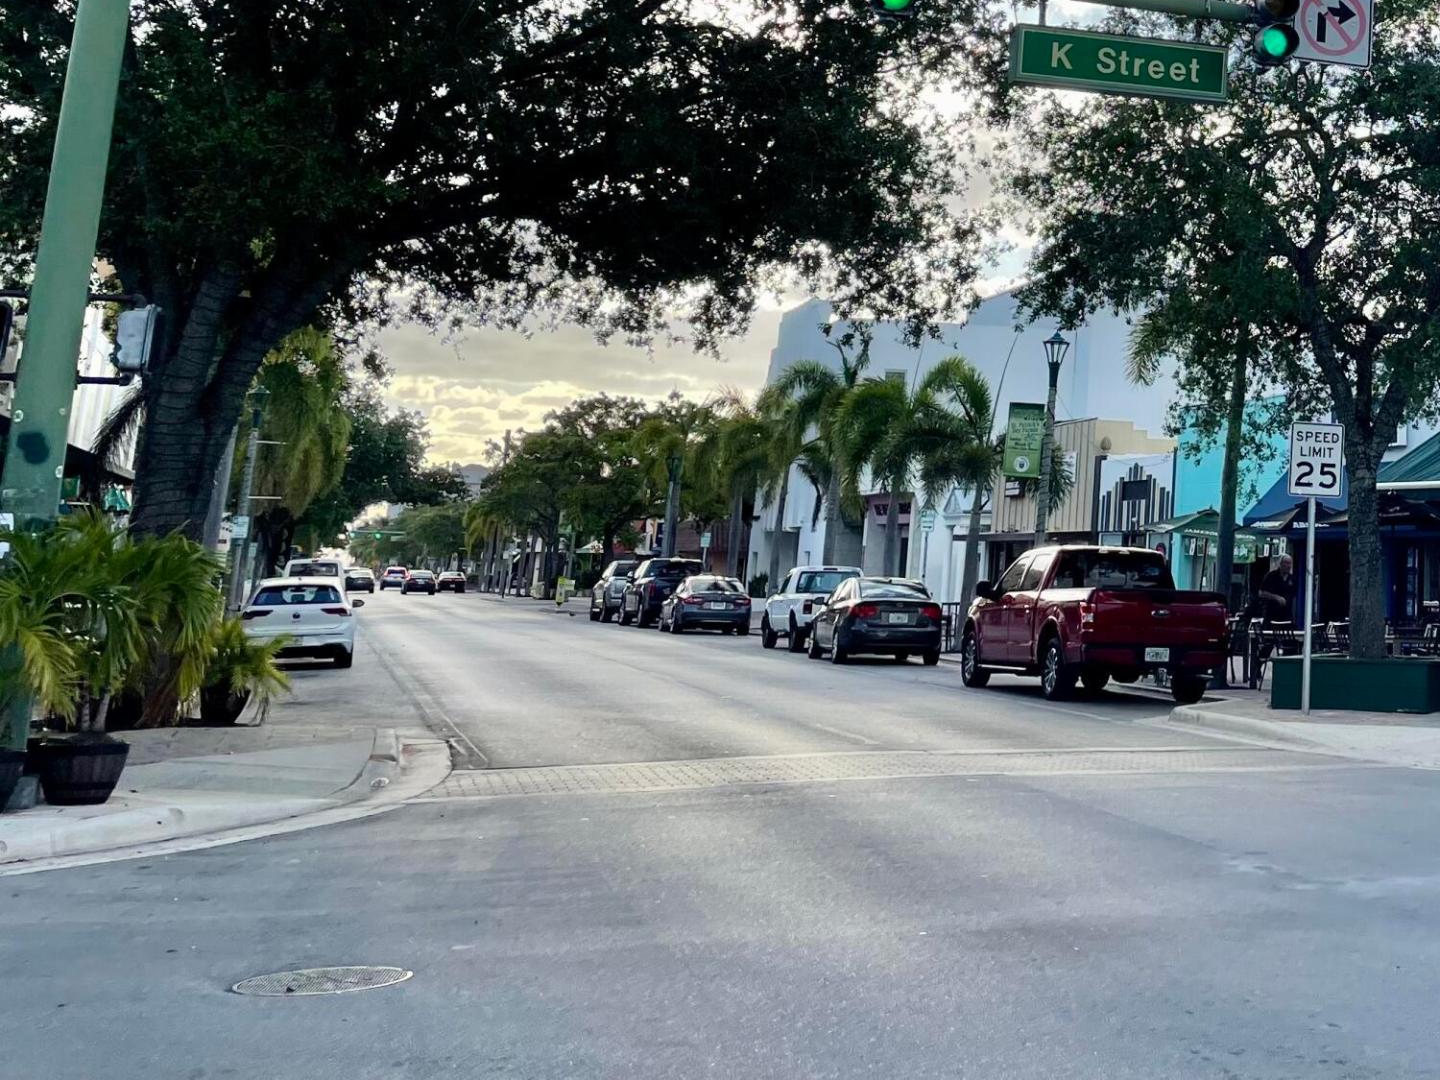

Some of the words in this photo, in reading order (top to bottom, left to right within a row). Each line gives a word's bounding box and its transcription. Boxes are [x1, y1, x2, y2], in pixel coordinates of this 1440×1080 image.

[1051, 41, 1073, 70] K
[1096, 47, 1200, 83] Street
[1296, 431, 1340, 444] SPEED
[1300, 446, 1334, 458] LIMIT
[1294, 461, 1337, 489] 25
